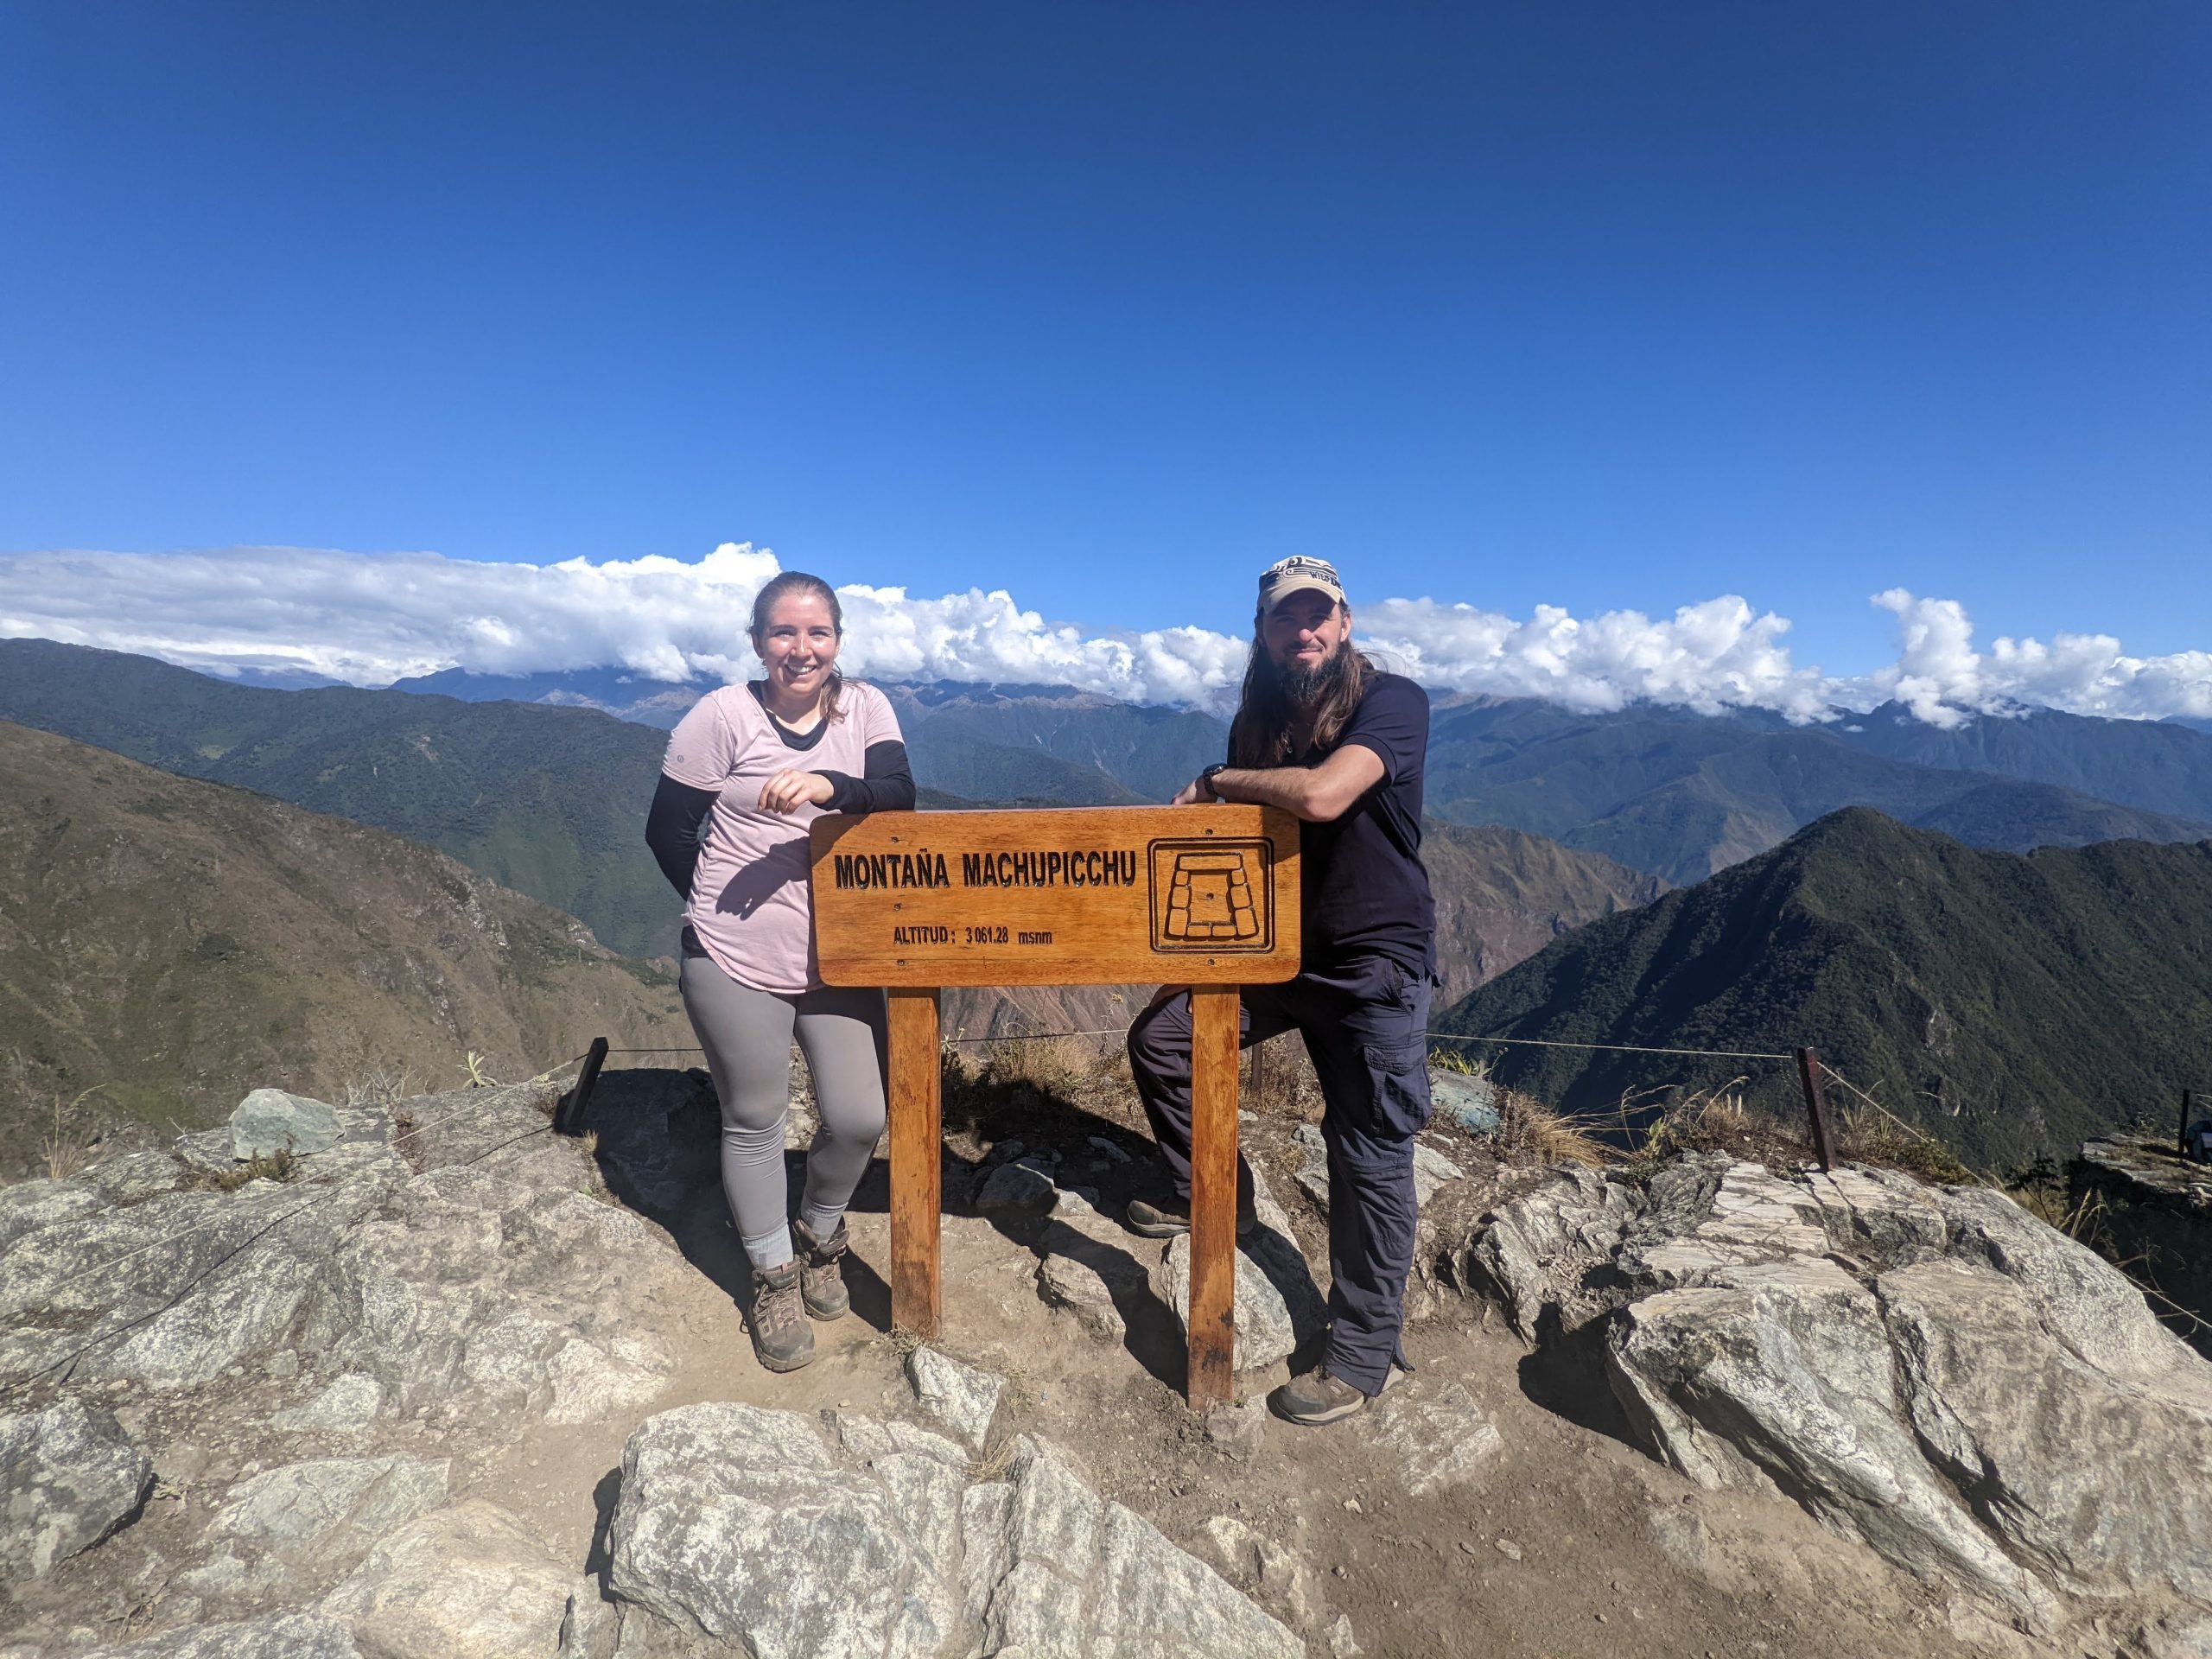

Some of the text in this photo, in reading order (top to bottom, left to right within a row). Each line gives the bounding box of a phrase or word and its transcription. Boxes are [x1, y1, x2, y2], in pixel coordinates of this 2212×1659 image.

[835, 848, 1136, 889] MONTAÑA MACHUPICCHU
[1018, 931, 1053, 945] msnm
